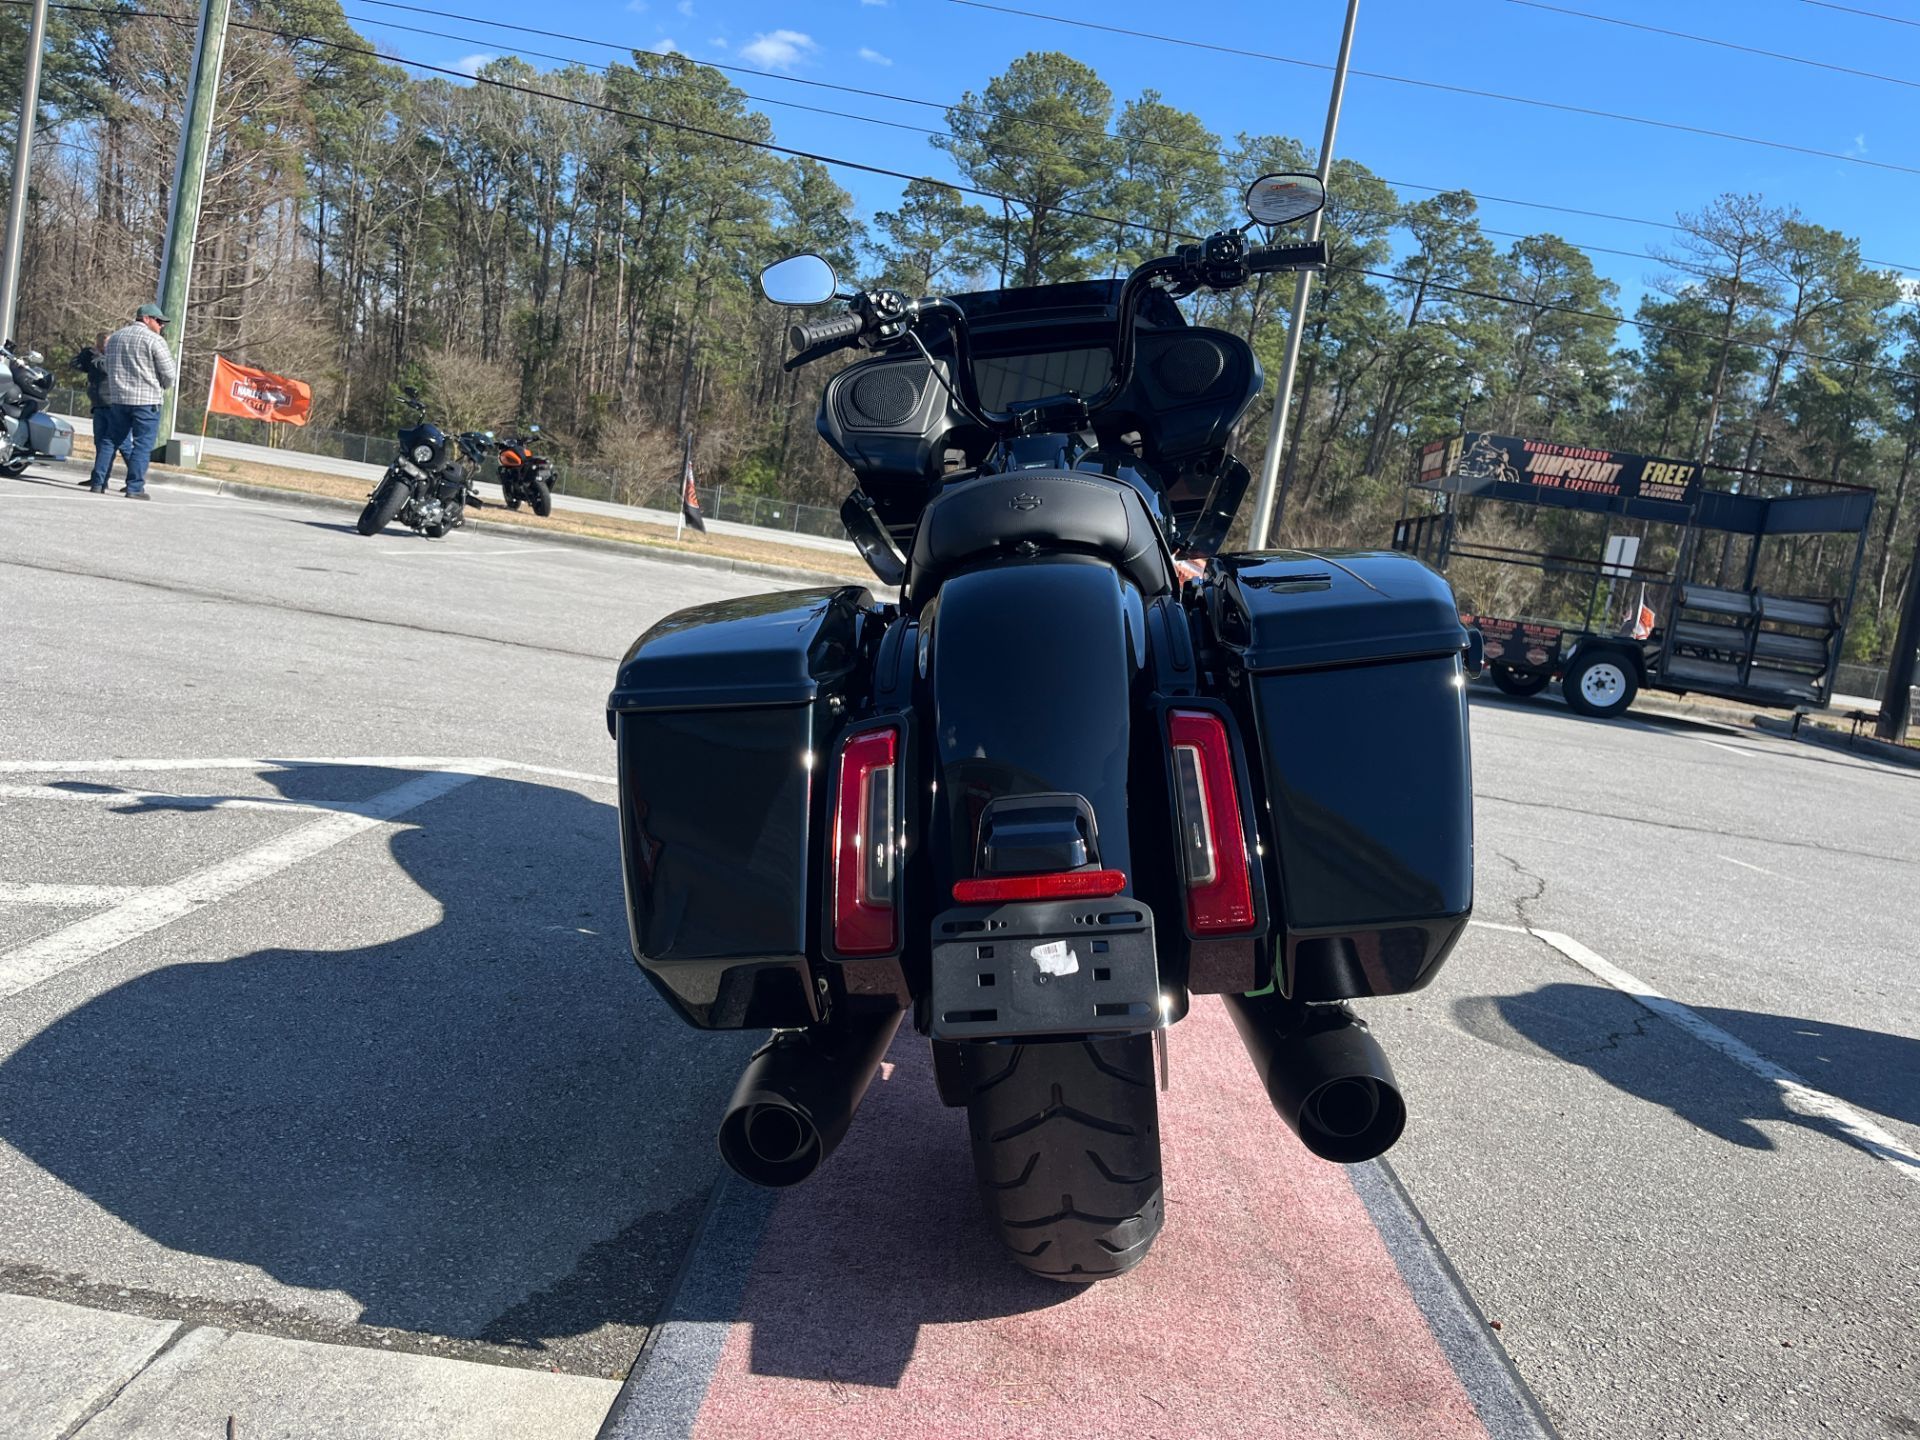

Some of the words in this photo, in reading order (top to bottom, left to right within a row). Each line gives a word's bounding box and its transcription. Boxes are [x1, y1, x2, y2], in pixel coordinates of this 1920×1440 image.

[1524, 441, 1610, 461] HARLEY-DAVIDSON
[1525, 453, 1624, 483] JUMPSTART
[1640, 461, 1695, 486] FREE!
[1532, 474, 1561, 488] RIDER
[1564, 478, 1621, 495] EXPERIENCE
